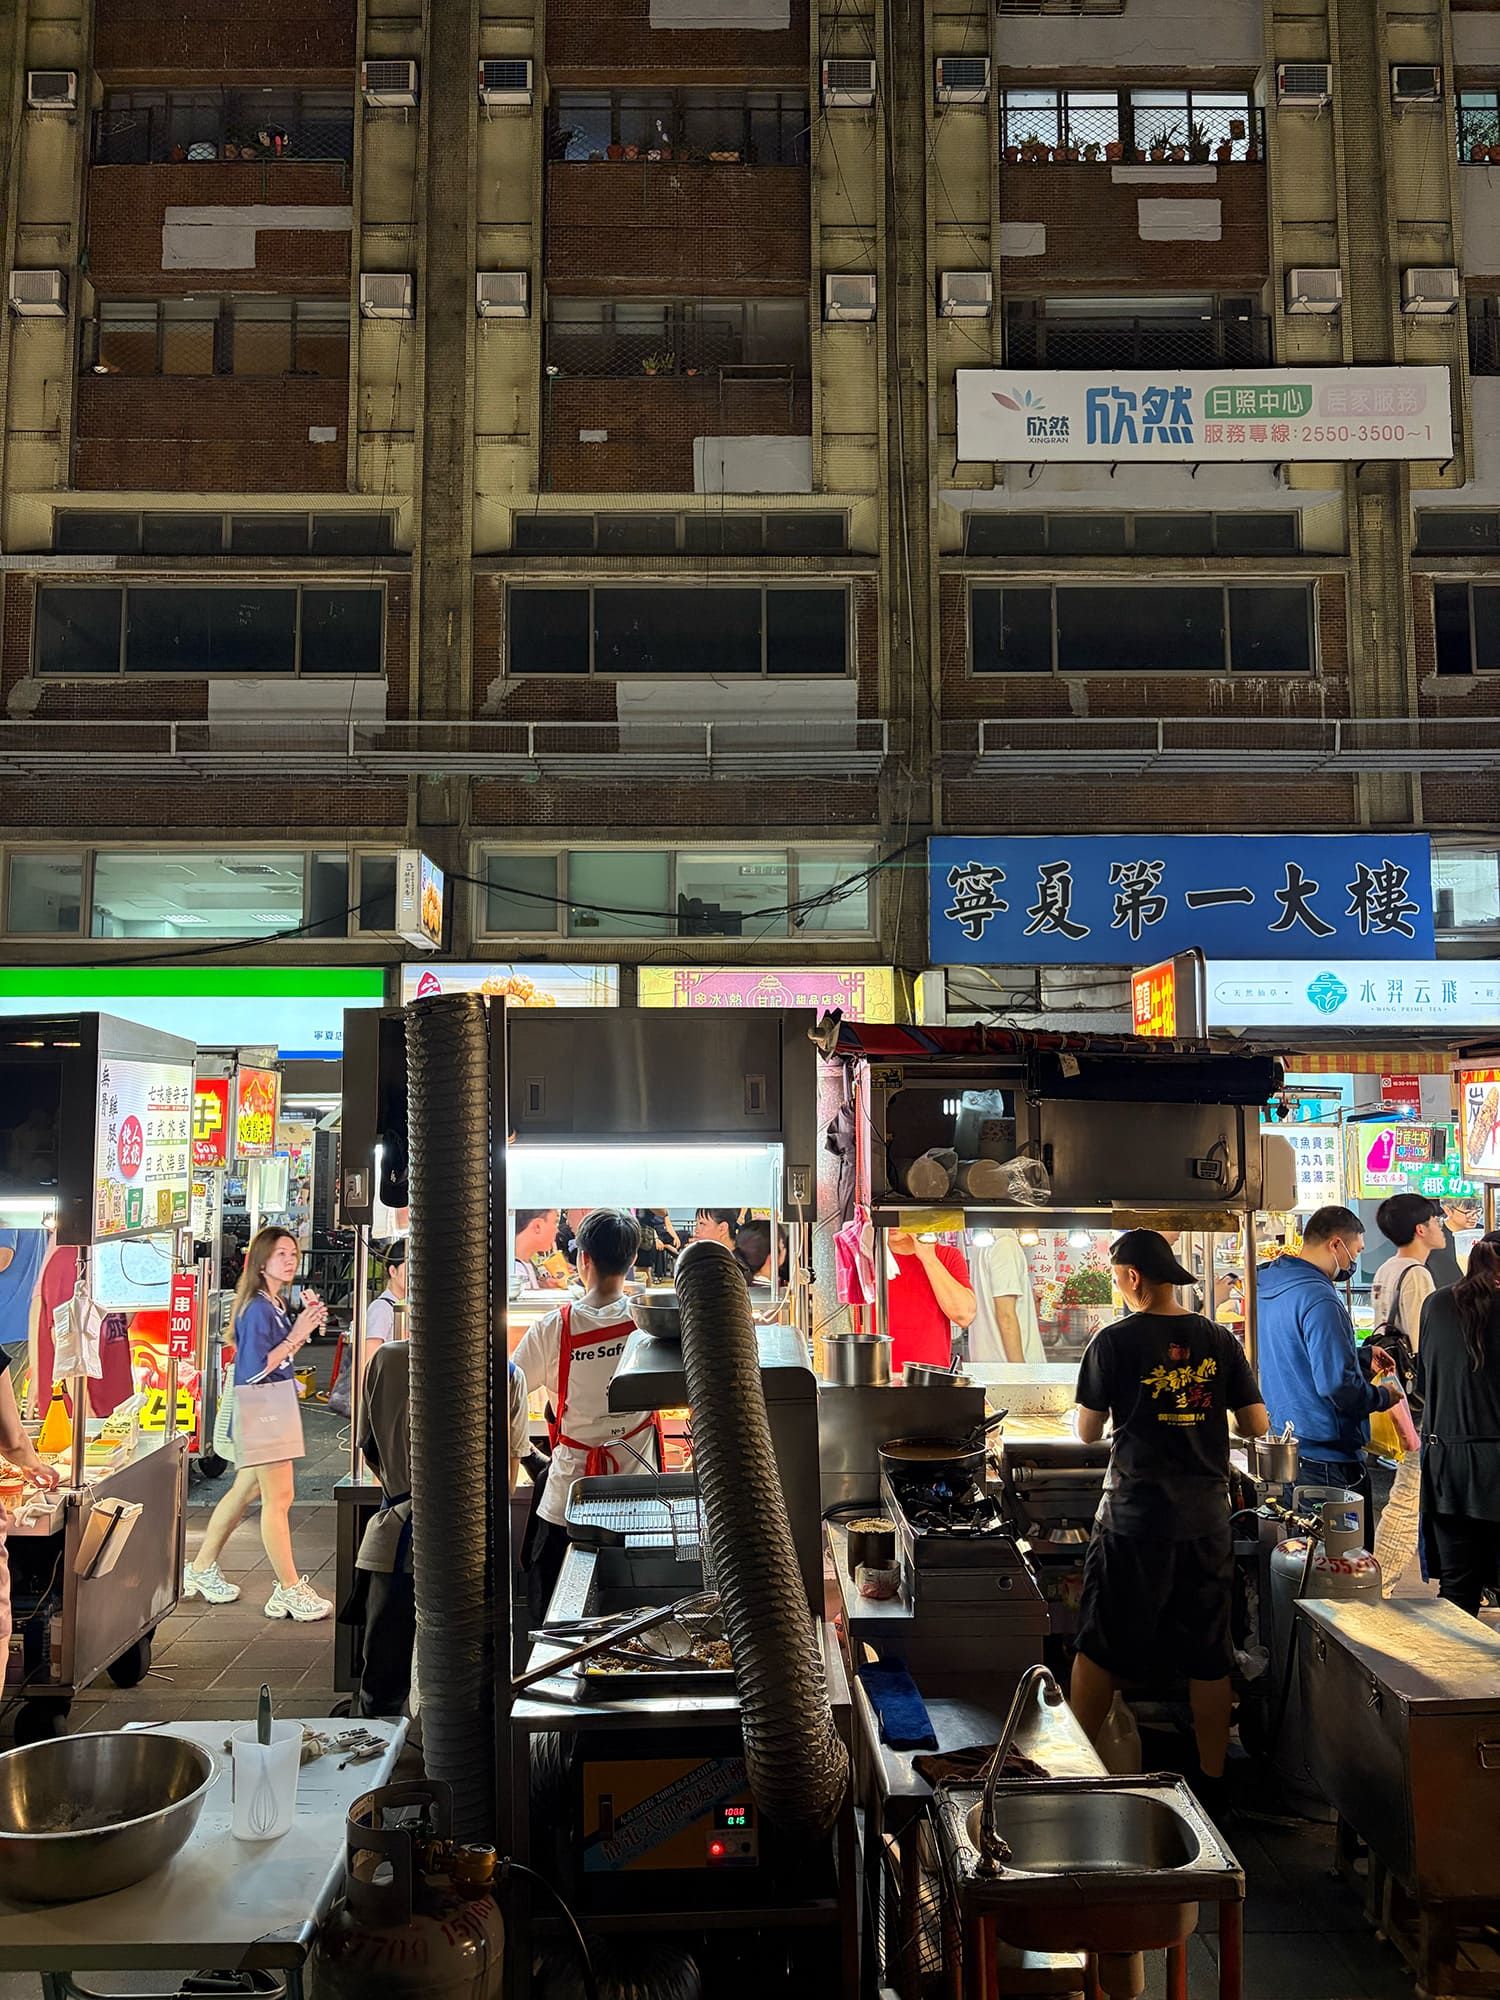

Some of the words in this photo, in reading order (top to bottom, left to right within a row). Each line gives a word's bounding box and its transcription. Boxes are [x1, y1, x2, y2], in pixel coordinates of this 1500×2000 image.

[1211, 388, 1304, 416] 日照中心
[1326, 386, 1419, 413] 居家服務
[1026, 415, 1070, 437] 欣然
[1087, 385, 1193, 445] 欣然
[1027, 436, 1070, 444] XINGRAN
[944, 860, 1420, 941] 寧夏第一大樓
[1359, 979, 1458, 1003] 水羿云飛
